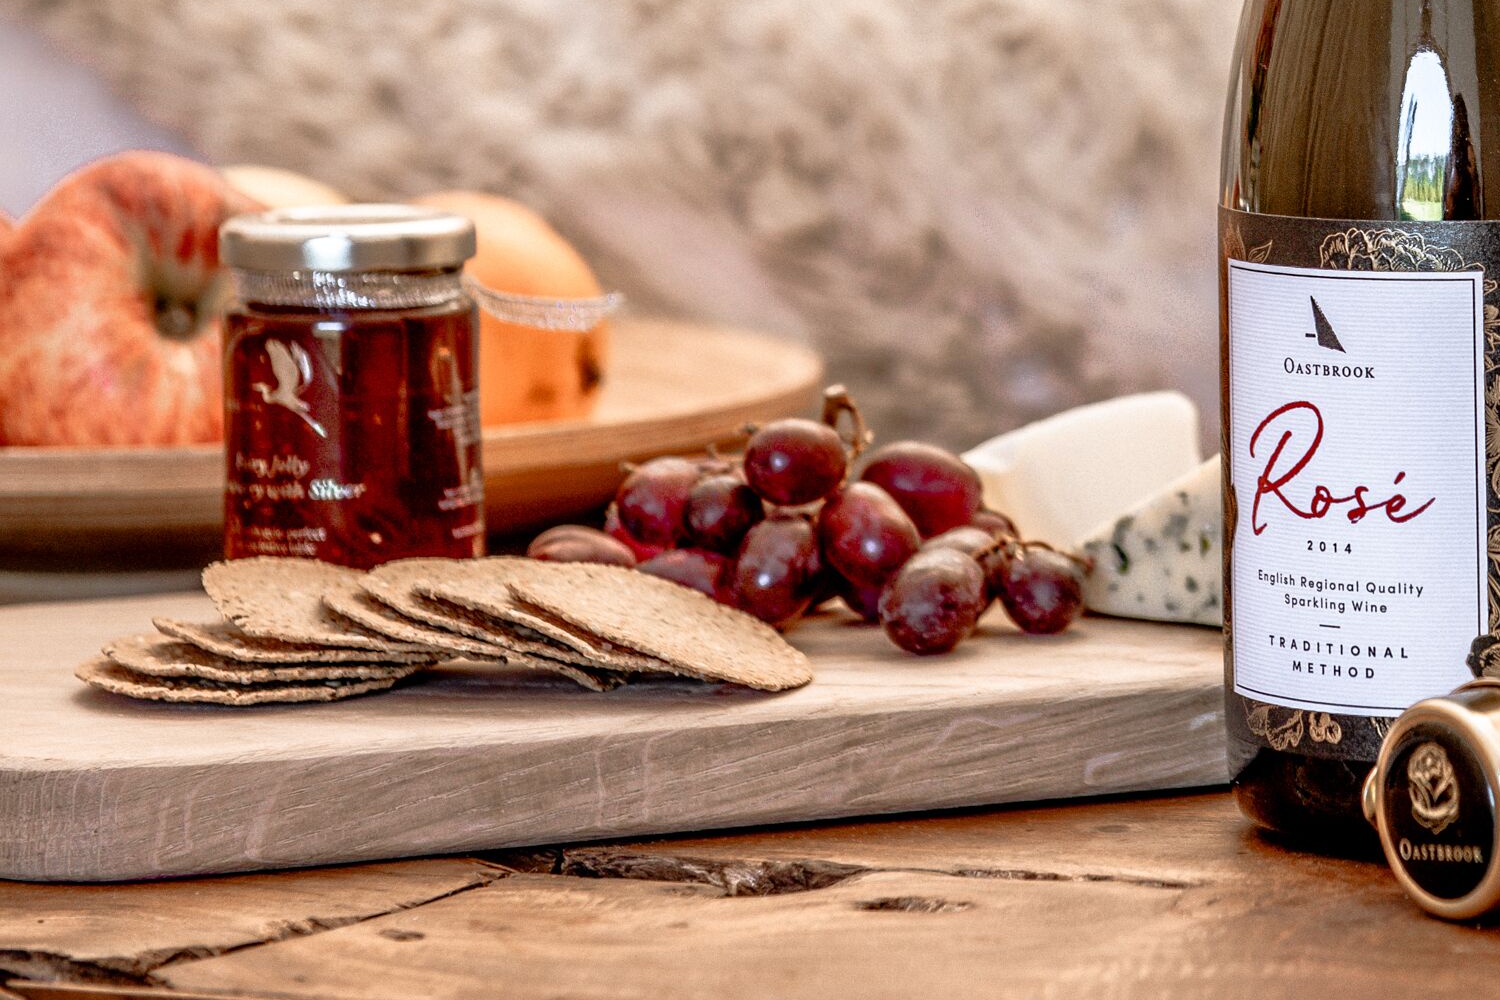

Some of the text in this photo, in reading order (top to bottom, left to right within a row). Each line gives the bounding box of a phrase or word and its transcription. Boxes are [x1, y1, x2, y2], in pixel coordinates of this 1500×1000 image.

[1284, 357, 1375, 379] OASTBROOK
[1250, 401, 1435, 535] Rosé
[1307, 540, 1352, 554] 2014
[1258, 569, 1424, 597] English Regional Quality
[1284, 593, 1388, 613] Sparkling Wine
[1269, 635, 1408, 658] TRADITIONAL
[1293, 660, 1375, 679] METHOD
[1399, 838, 1483, 863] OASTBROOK
